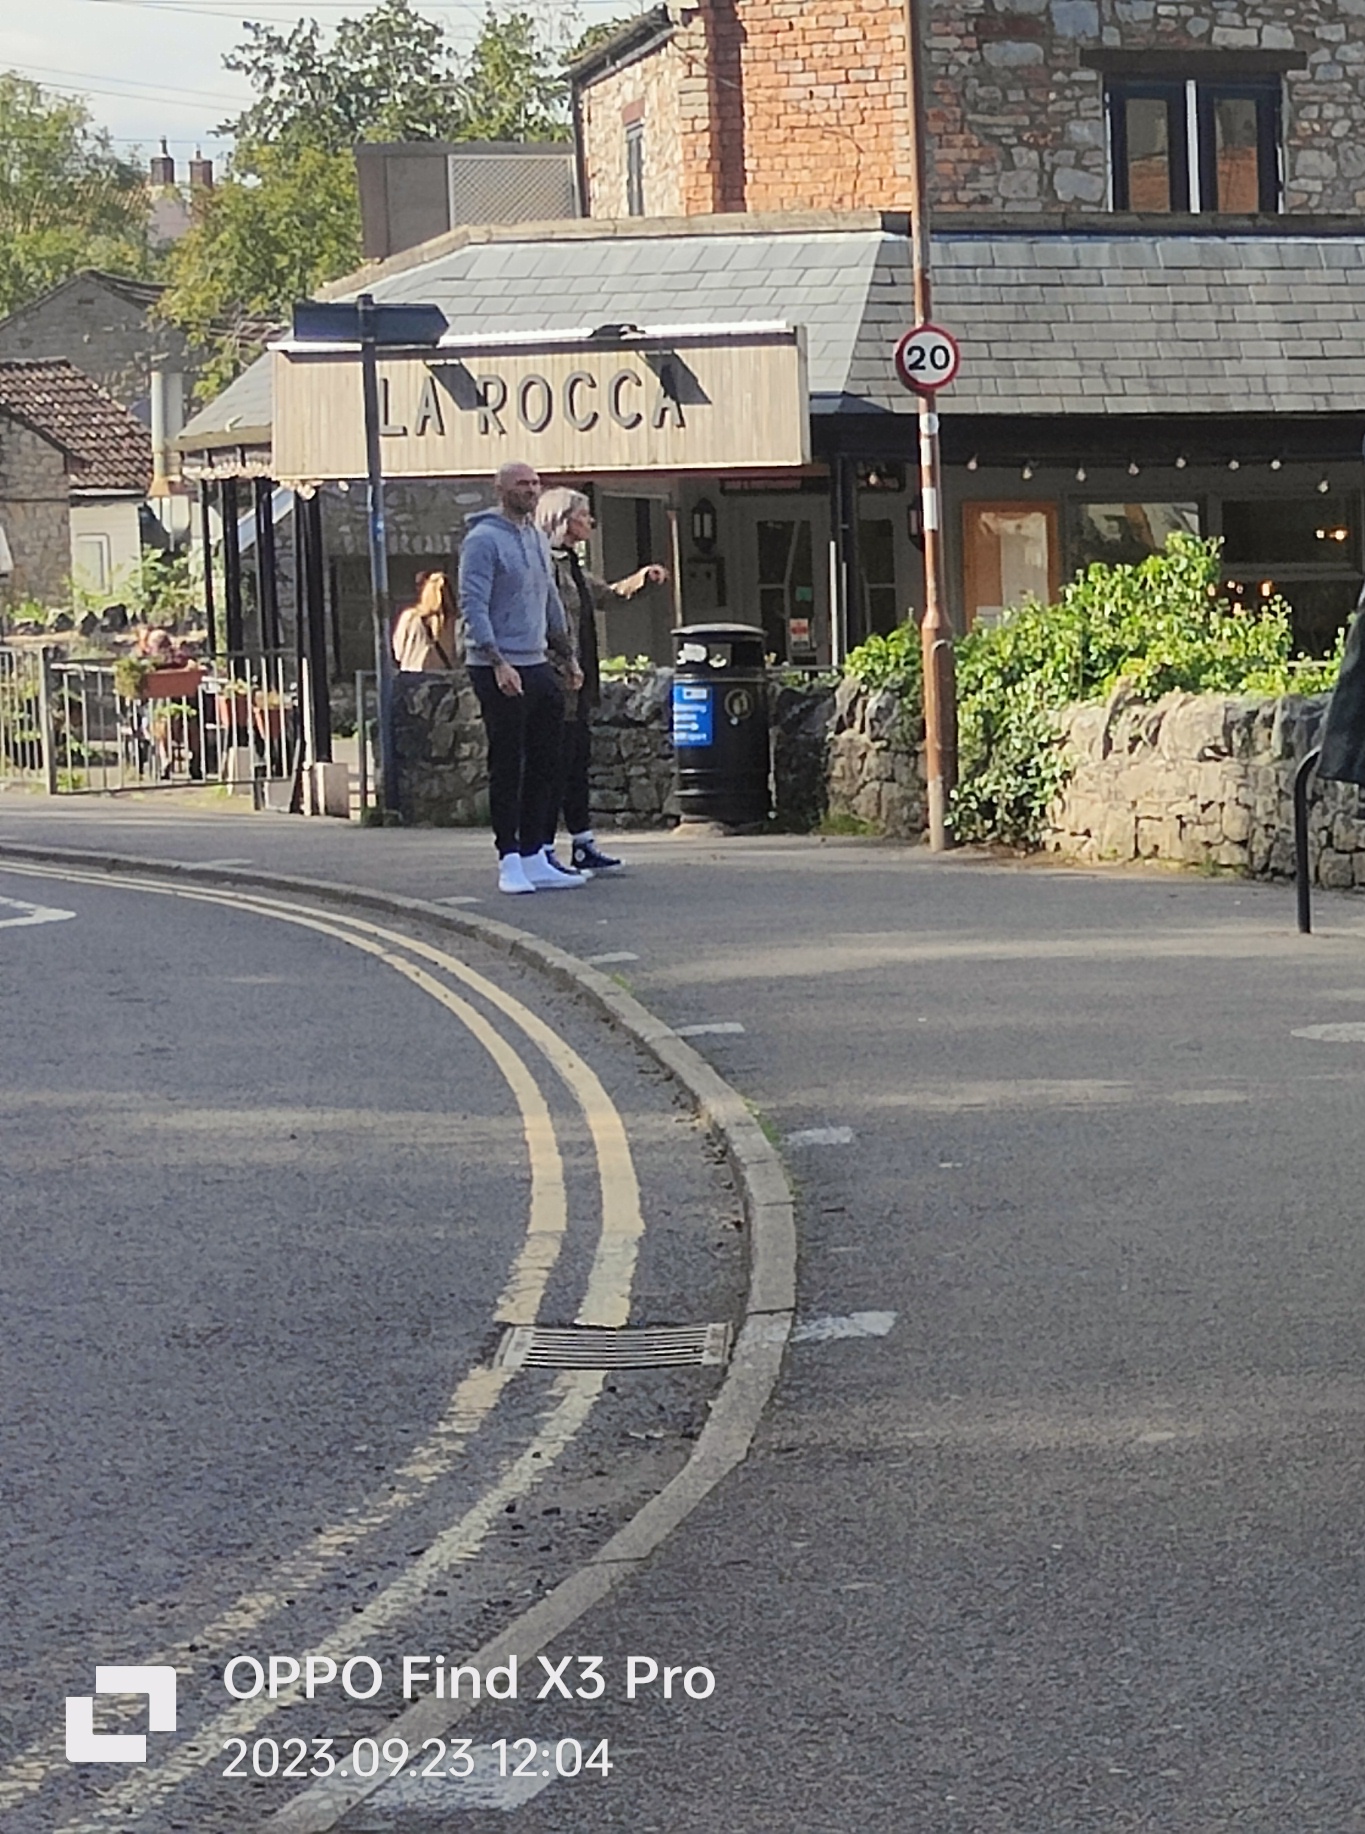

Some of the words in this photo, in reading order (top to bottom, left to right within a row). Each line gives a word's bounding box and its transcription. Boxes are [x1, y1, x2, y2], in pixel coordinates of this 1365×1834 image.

[907, 345, 950, 370] 20
[378, 375, 446, 437] LA
[476, 365, 686, 436] ROCCA
